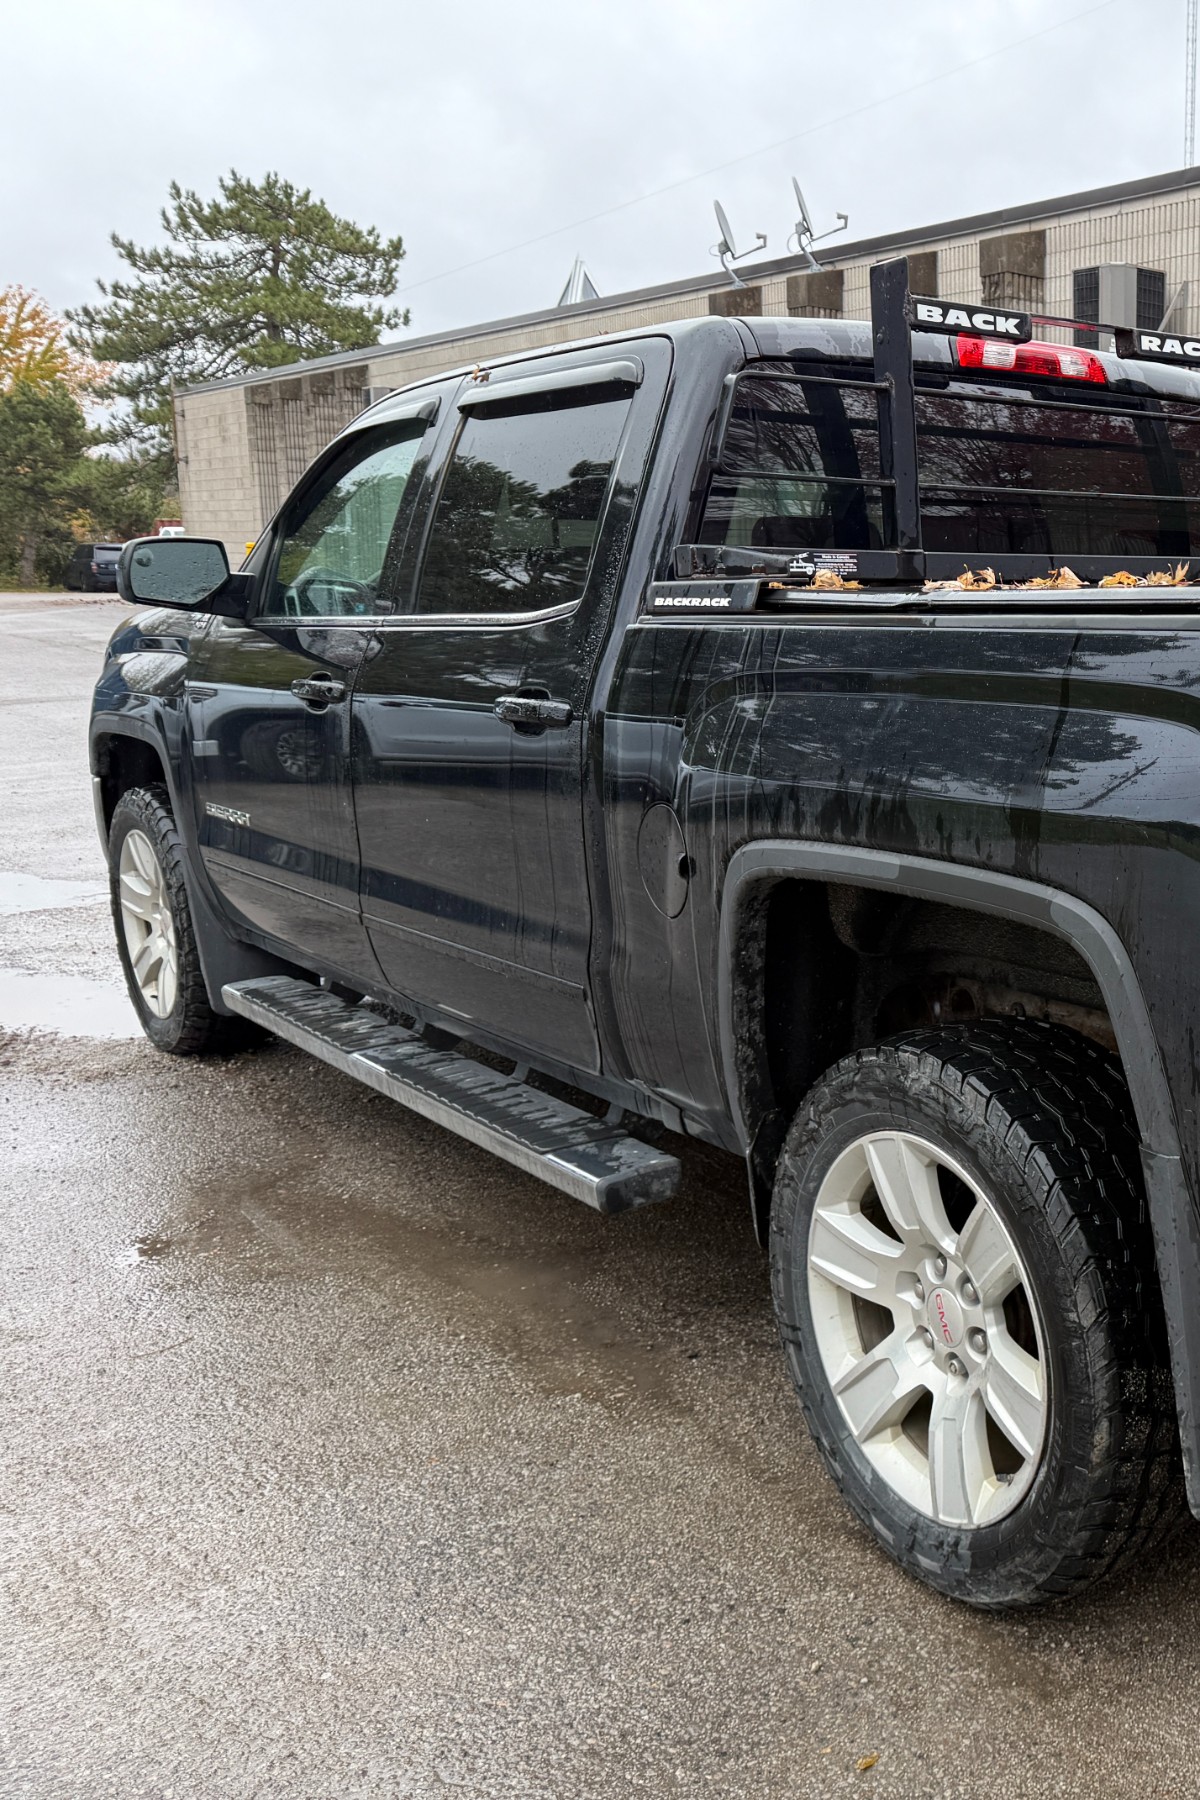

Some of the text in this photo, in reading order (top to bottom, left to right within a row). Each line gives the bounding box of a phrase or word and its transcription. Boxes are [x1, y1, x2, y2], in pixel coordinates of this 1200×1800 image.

[916, 304, 1021, 335] BACK
[654, 598, 730, 607] BACKRACK
[206, 802, 251, 827] SIERRA
[935, 1293, 954, 1344] GMC
